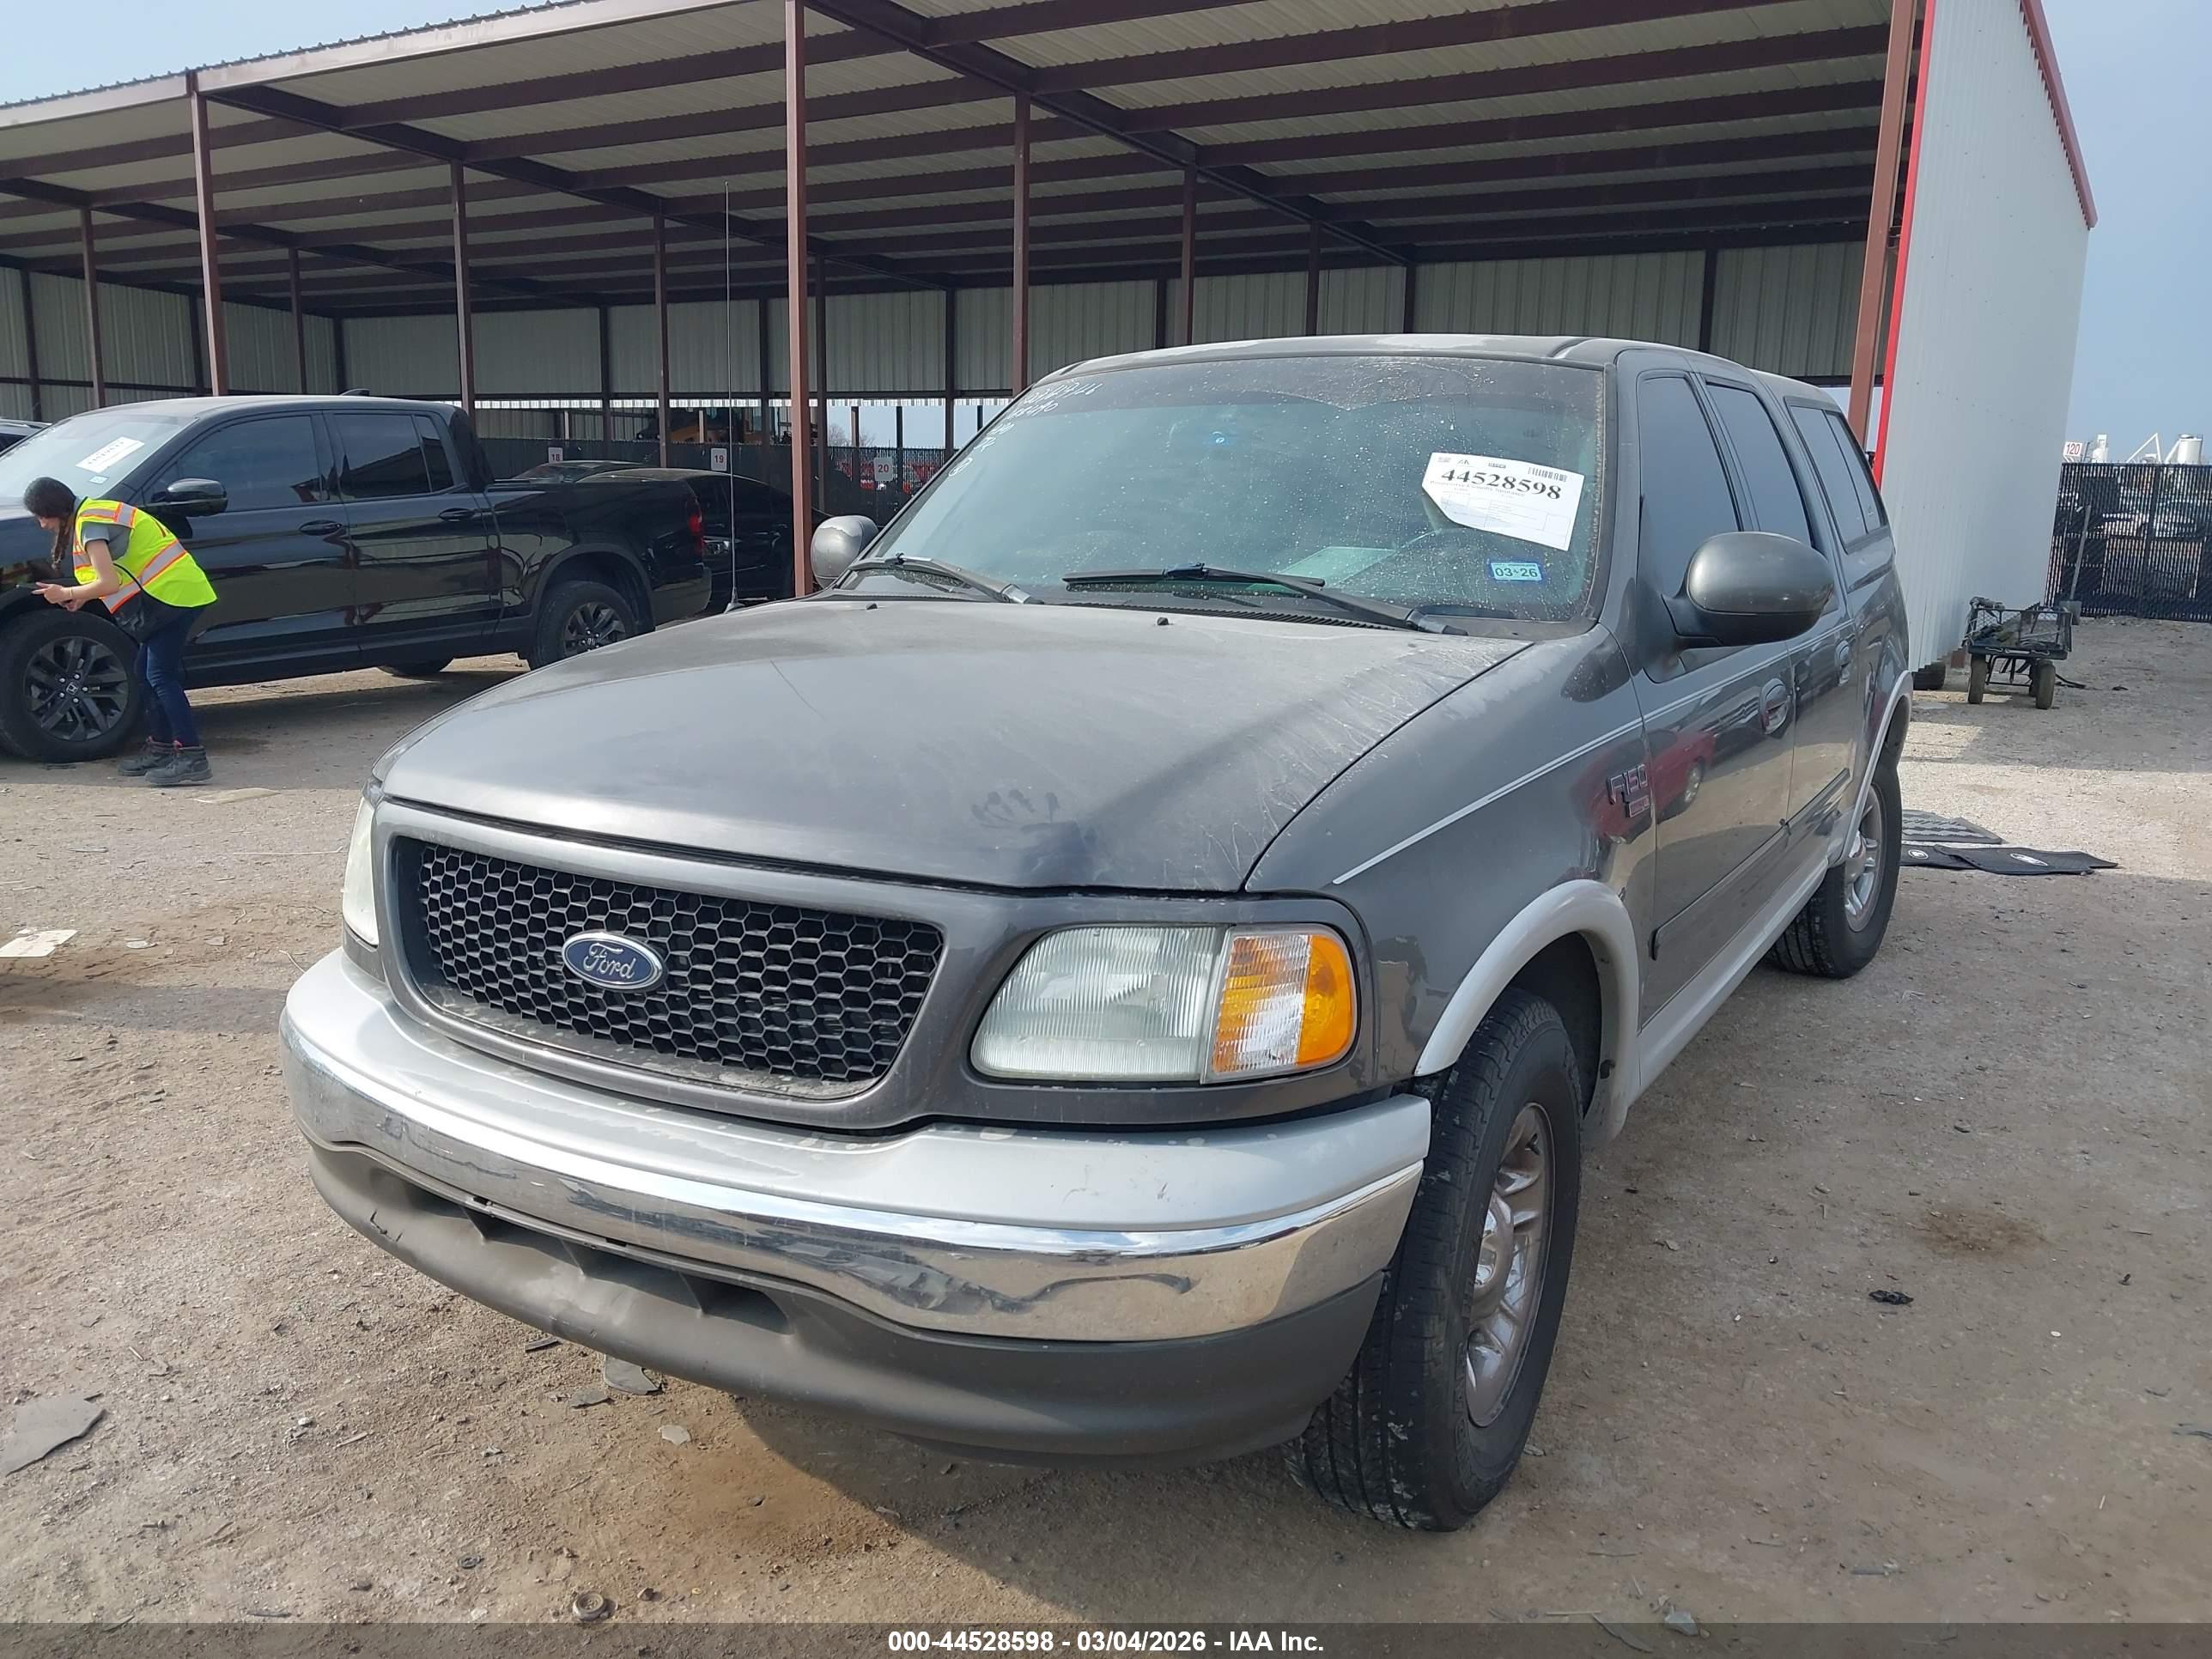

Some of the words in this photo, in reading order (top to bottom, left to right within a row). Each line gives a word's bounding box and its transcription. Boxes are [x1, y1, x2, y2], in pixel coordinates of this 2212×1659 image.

[2066, 443, 2080, 455] 120
[551, 453, 561, 462] 18
[714, 454, 724, 463] 19
[878, 464, 889, 473] 20
[1441, 469, 1562, 500] 44528598
[582, 942, 636, 979] Ford
